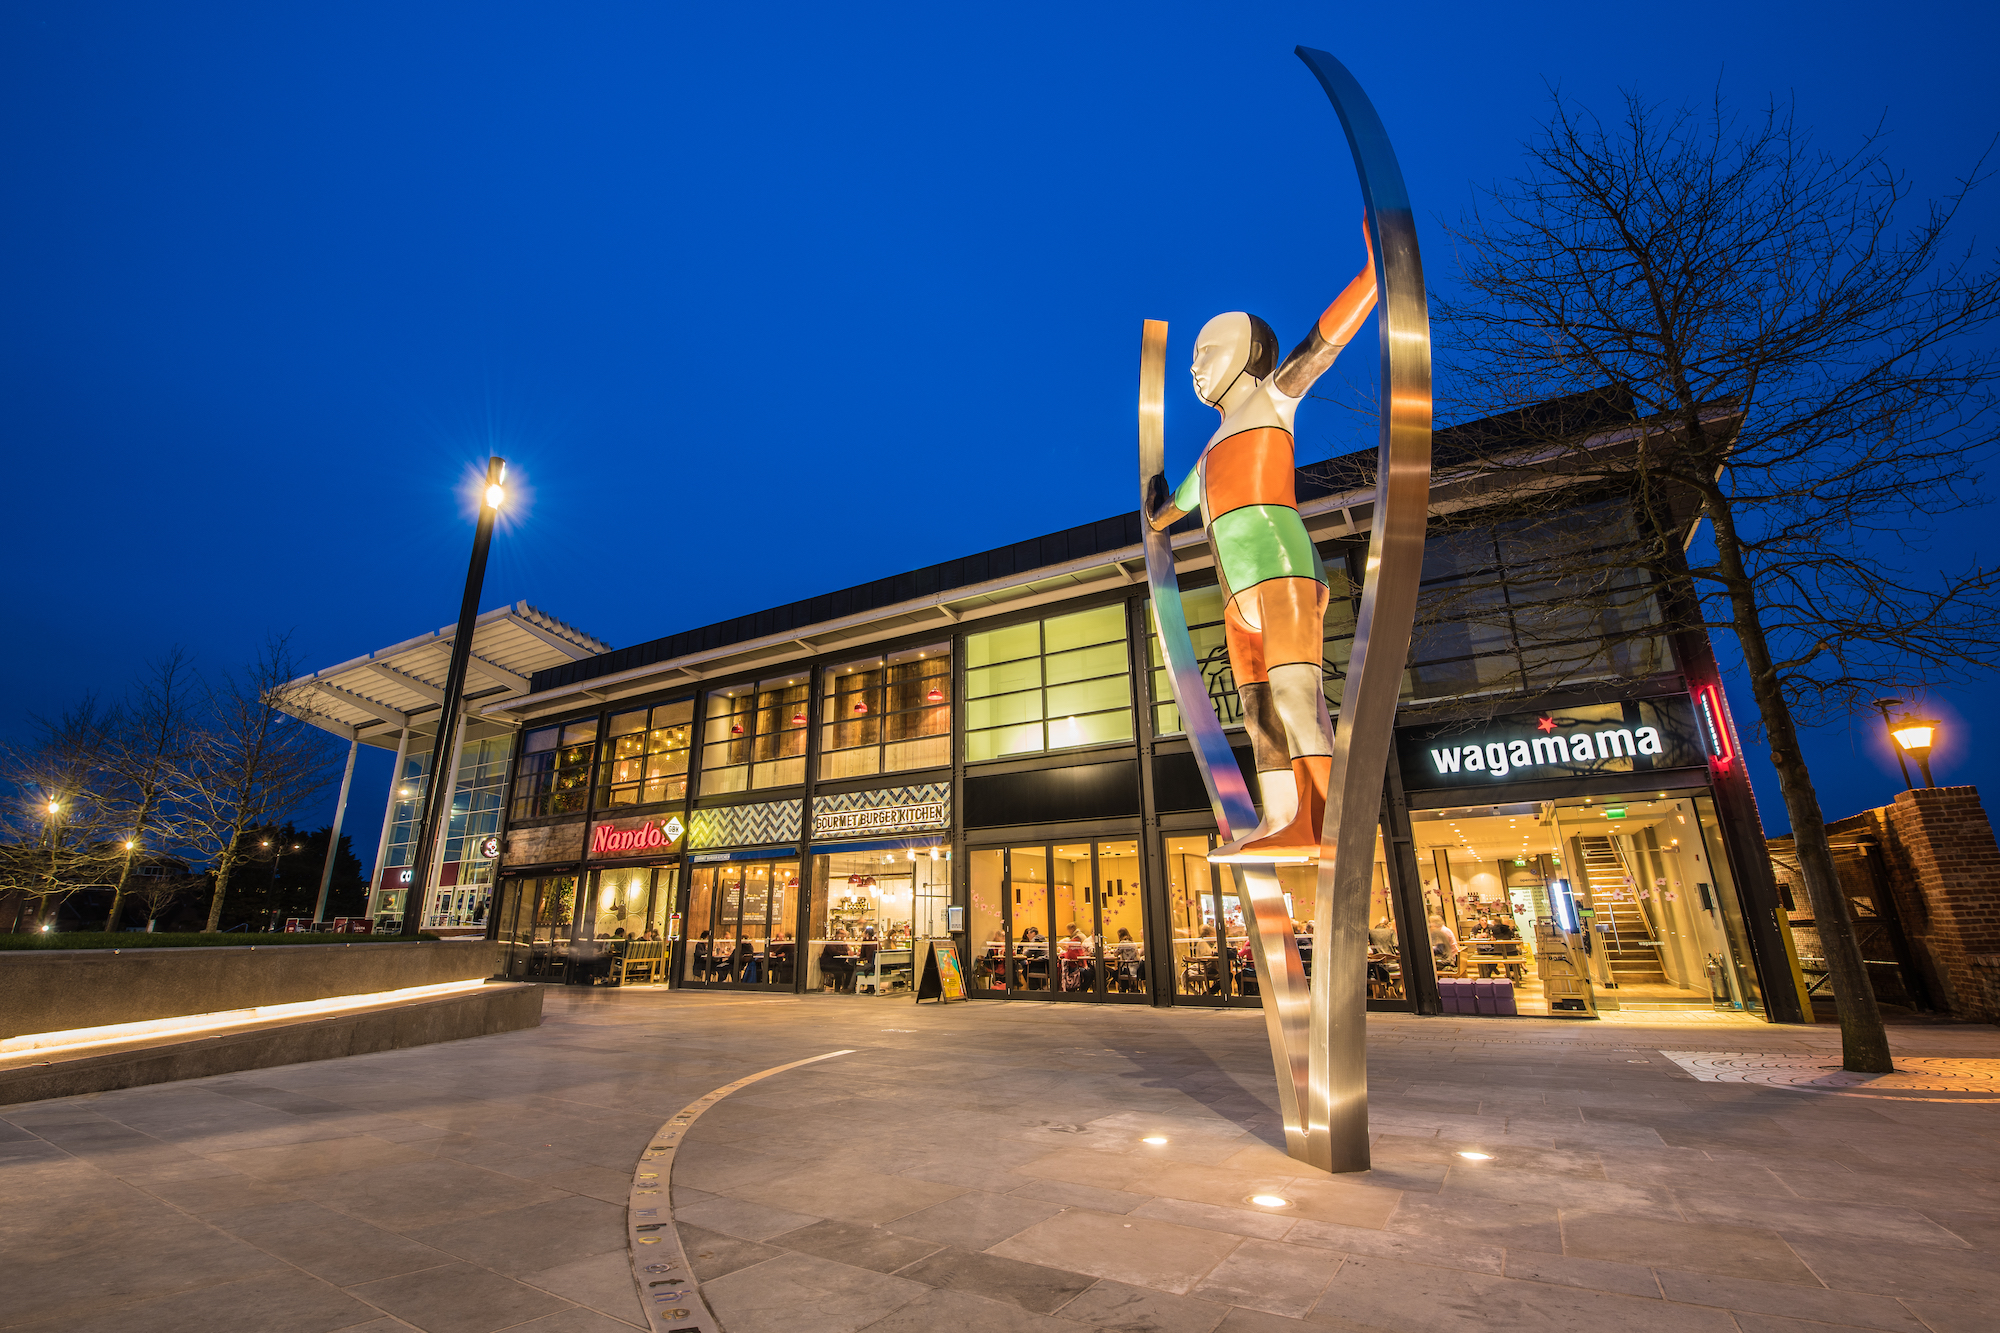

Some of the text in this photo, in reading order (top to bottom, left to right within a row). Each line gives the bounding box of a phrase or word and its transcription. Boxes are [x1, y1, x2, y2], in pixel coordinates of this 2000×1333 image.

[1431, 726, 1663, 777] wagamama
[667, 825, 680, 833] GBK
[816, 804, 943, 829] GOURMET BURGER KITCHEN
